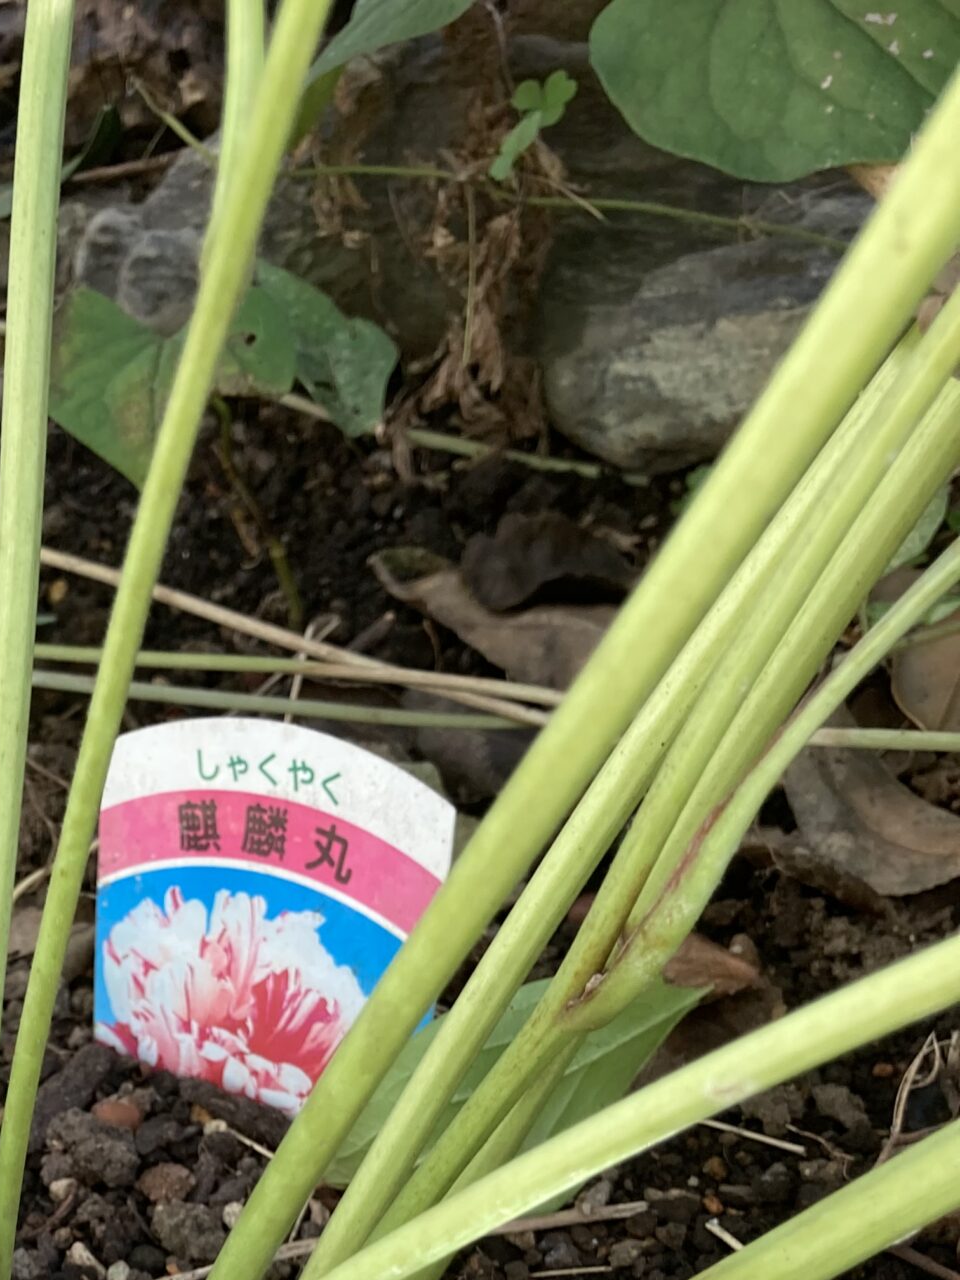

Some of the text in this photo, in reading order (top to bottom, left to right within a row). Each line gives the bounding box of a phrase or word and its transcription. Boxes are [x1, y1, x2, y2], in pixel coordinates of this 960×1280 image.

[196, 749, 342, 806] しゃくやく
[178, 799, 352, 885] 麒麟丸
